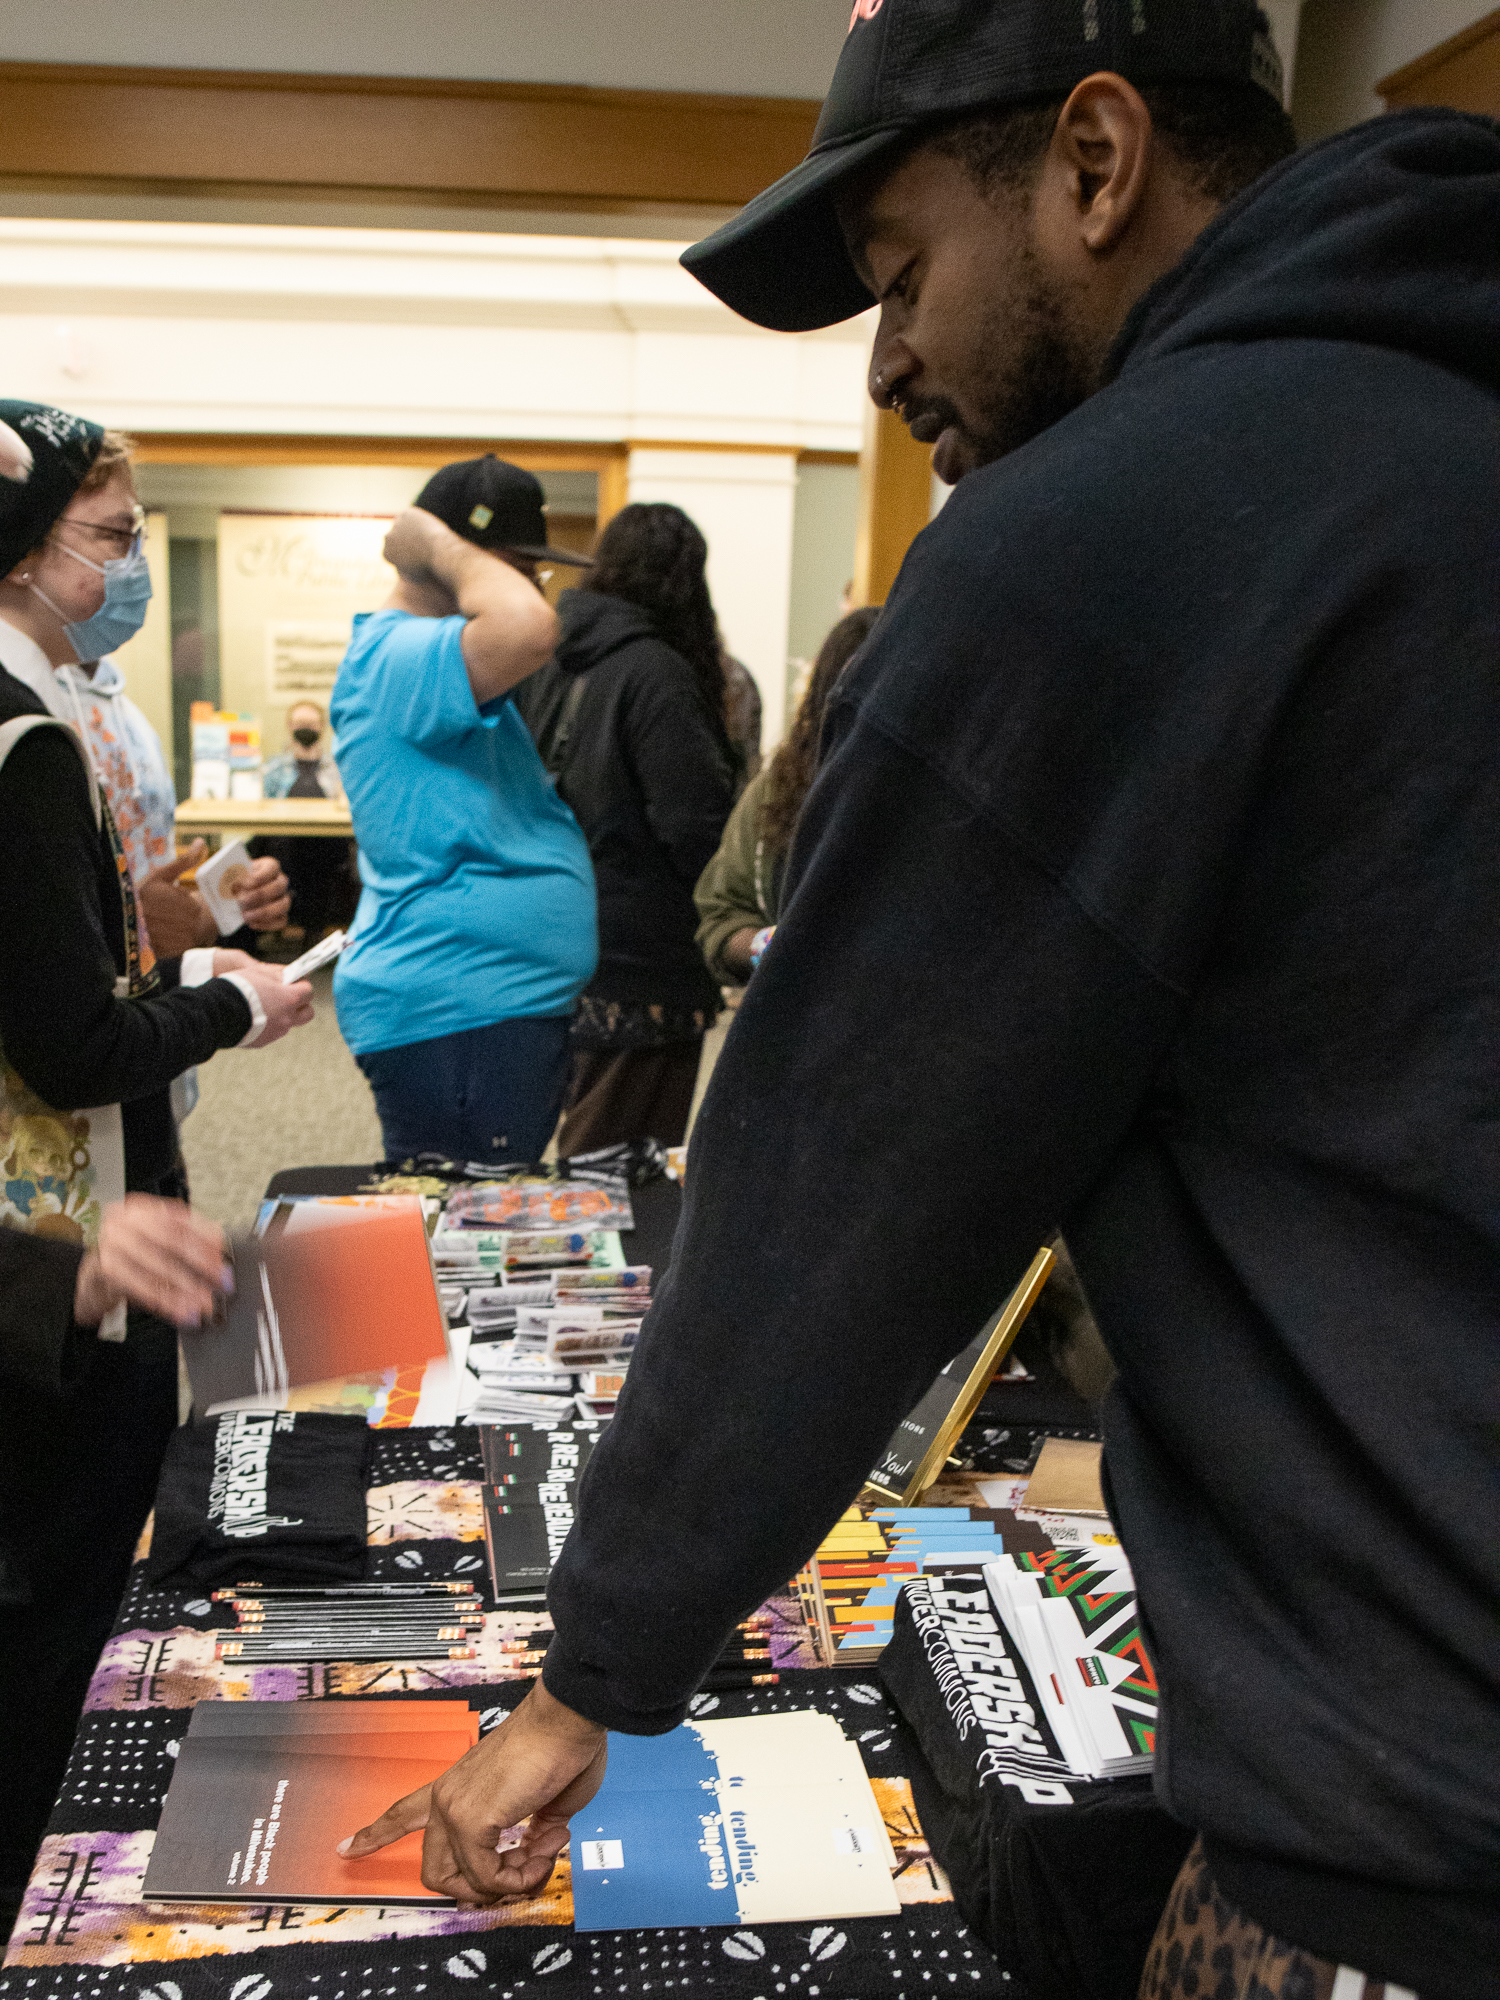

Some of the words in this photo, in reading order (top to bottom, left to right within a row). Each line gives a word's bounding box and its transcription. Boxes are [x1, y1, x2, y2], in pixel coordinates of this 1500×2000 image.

[207, 1410, 238, 1520] UNDERCOMMONS
[218, 1410, 292, 1538] LEADERSHIP
[881, 1451, 913, 1476] You!
[926, 1573, 1076, 1805] LEADERSHIP
[273, 1779, 290, 1804] there
[252, 1818, 266, 1829] in
[269, 1804, 282, 1821] are
[263, 1821, 281, 1850] Black
[227, 1850, 242, 1879] volume
[255, 1850, 272, 1886] people
[226, 1878, 237, 1886] 2
